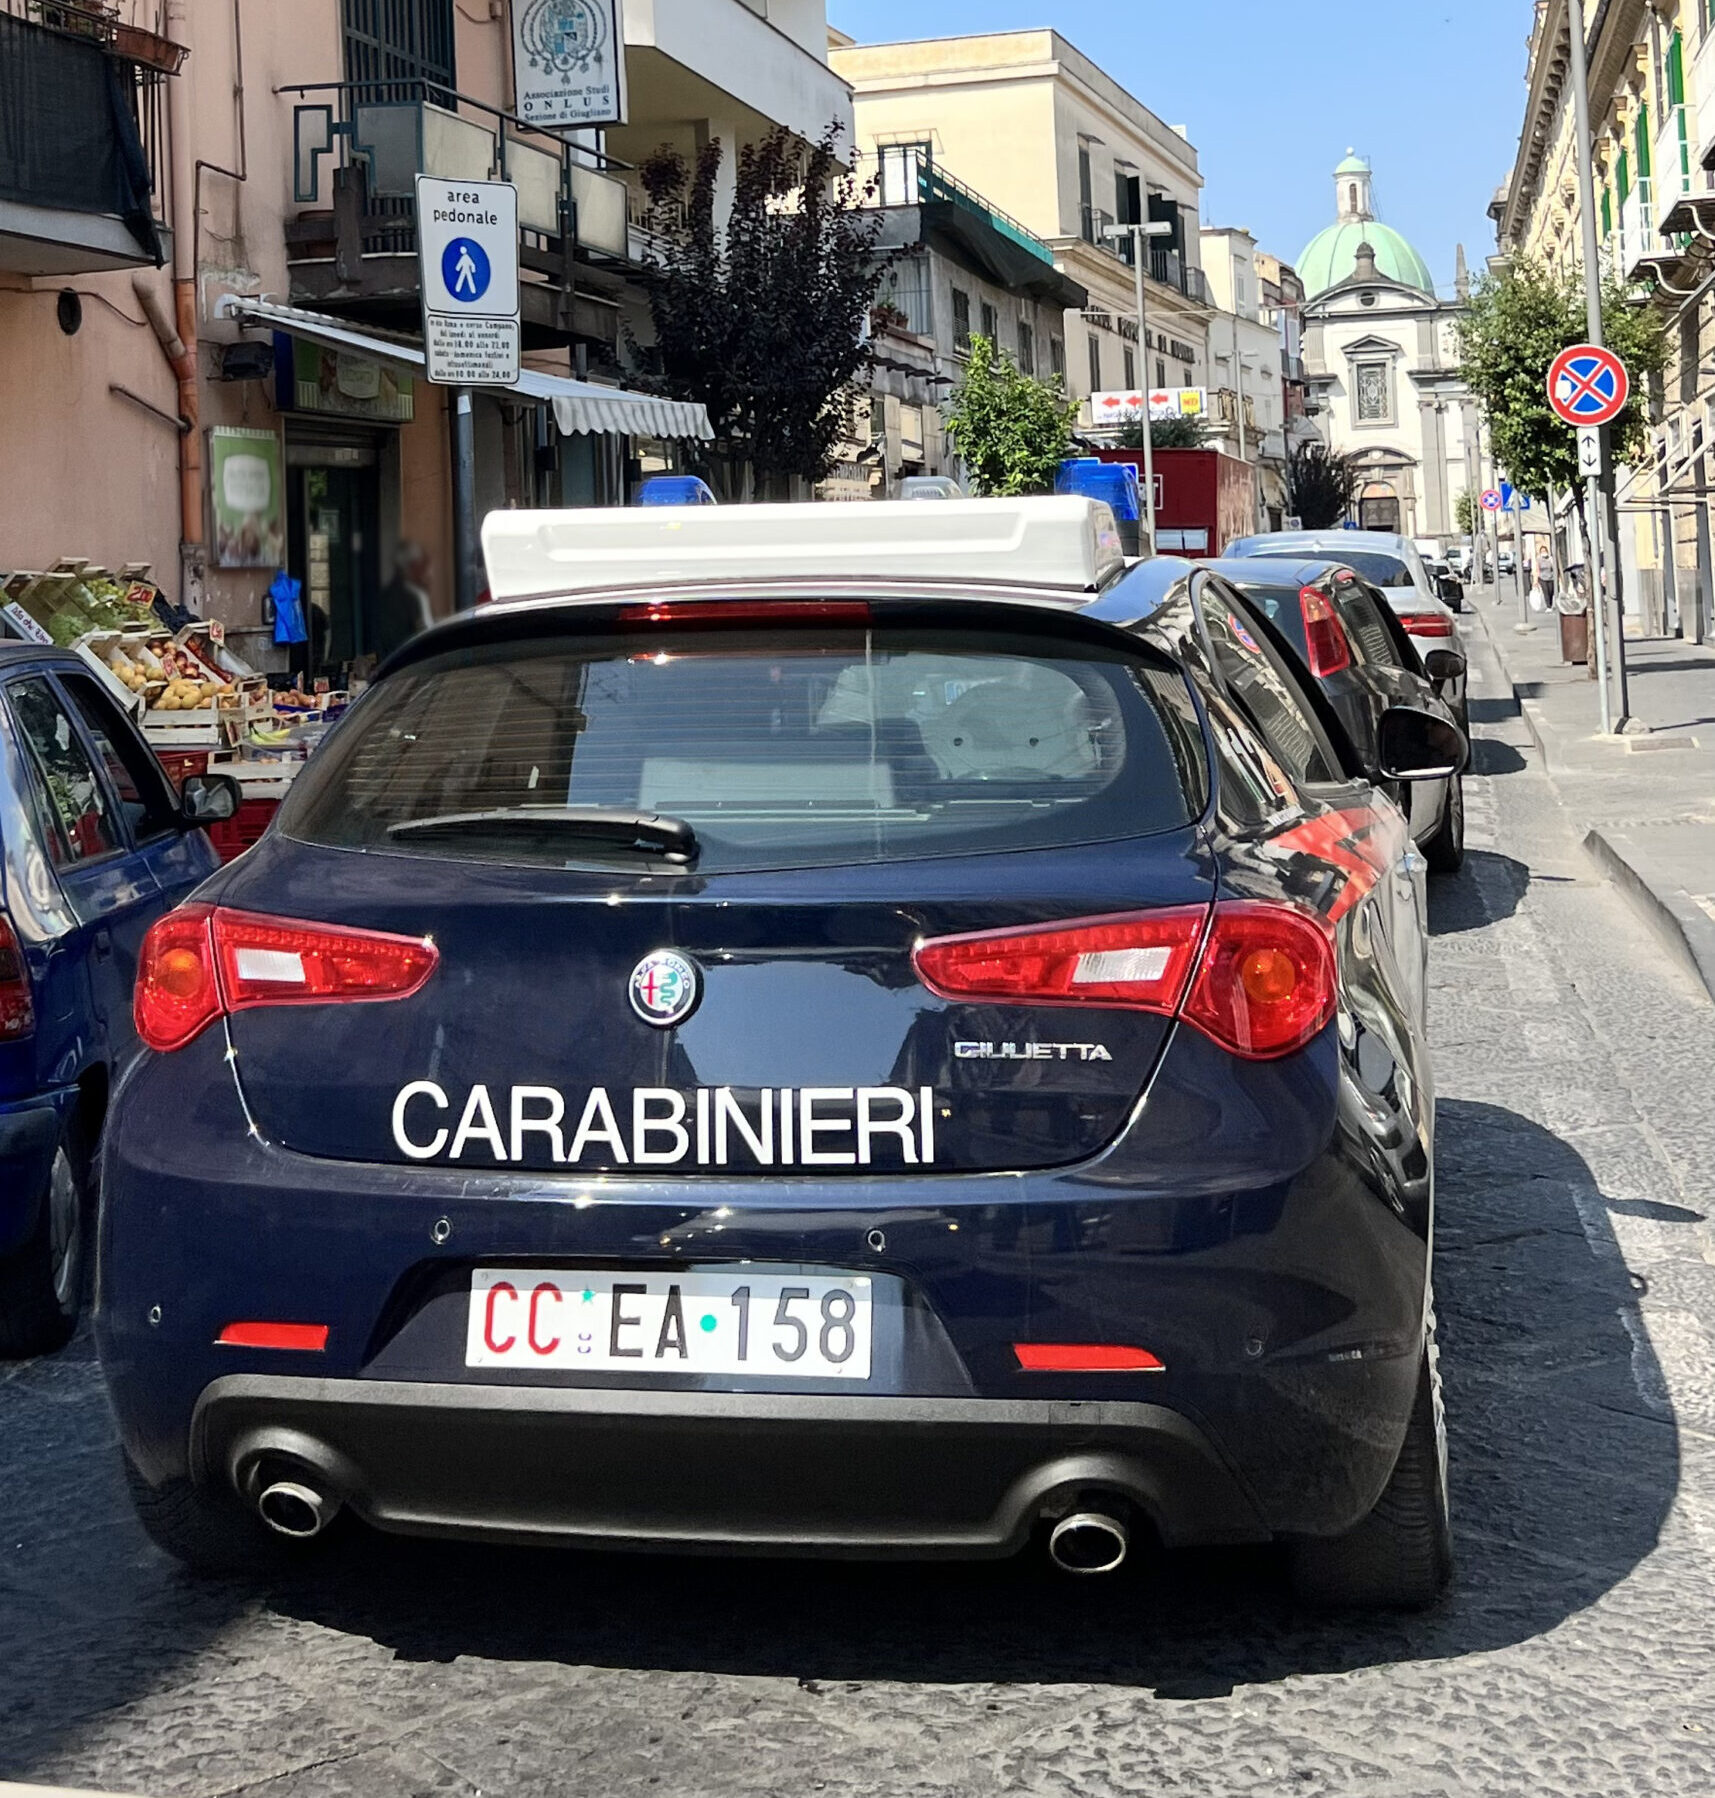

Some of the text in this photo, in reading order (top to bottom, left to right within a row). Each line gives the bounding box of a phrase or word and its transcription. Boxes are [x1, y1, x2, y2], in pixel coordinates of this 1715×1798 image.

[524, 84, 610, 100] Associazione Studi
[525, 108, 611, 121] Sezione di Giugliano
[447, 191, 480, 204] area
[433, 208, 498, 225] pedonale
[954, 1041, 1113, 1061] GIULIETTA
[391, 1080, 935, 1165] CARABINIERI
[484, 1281, 857, 1364] CC EA 158
